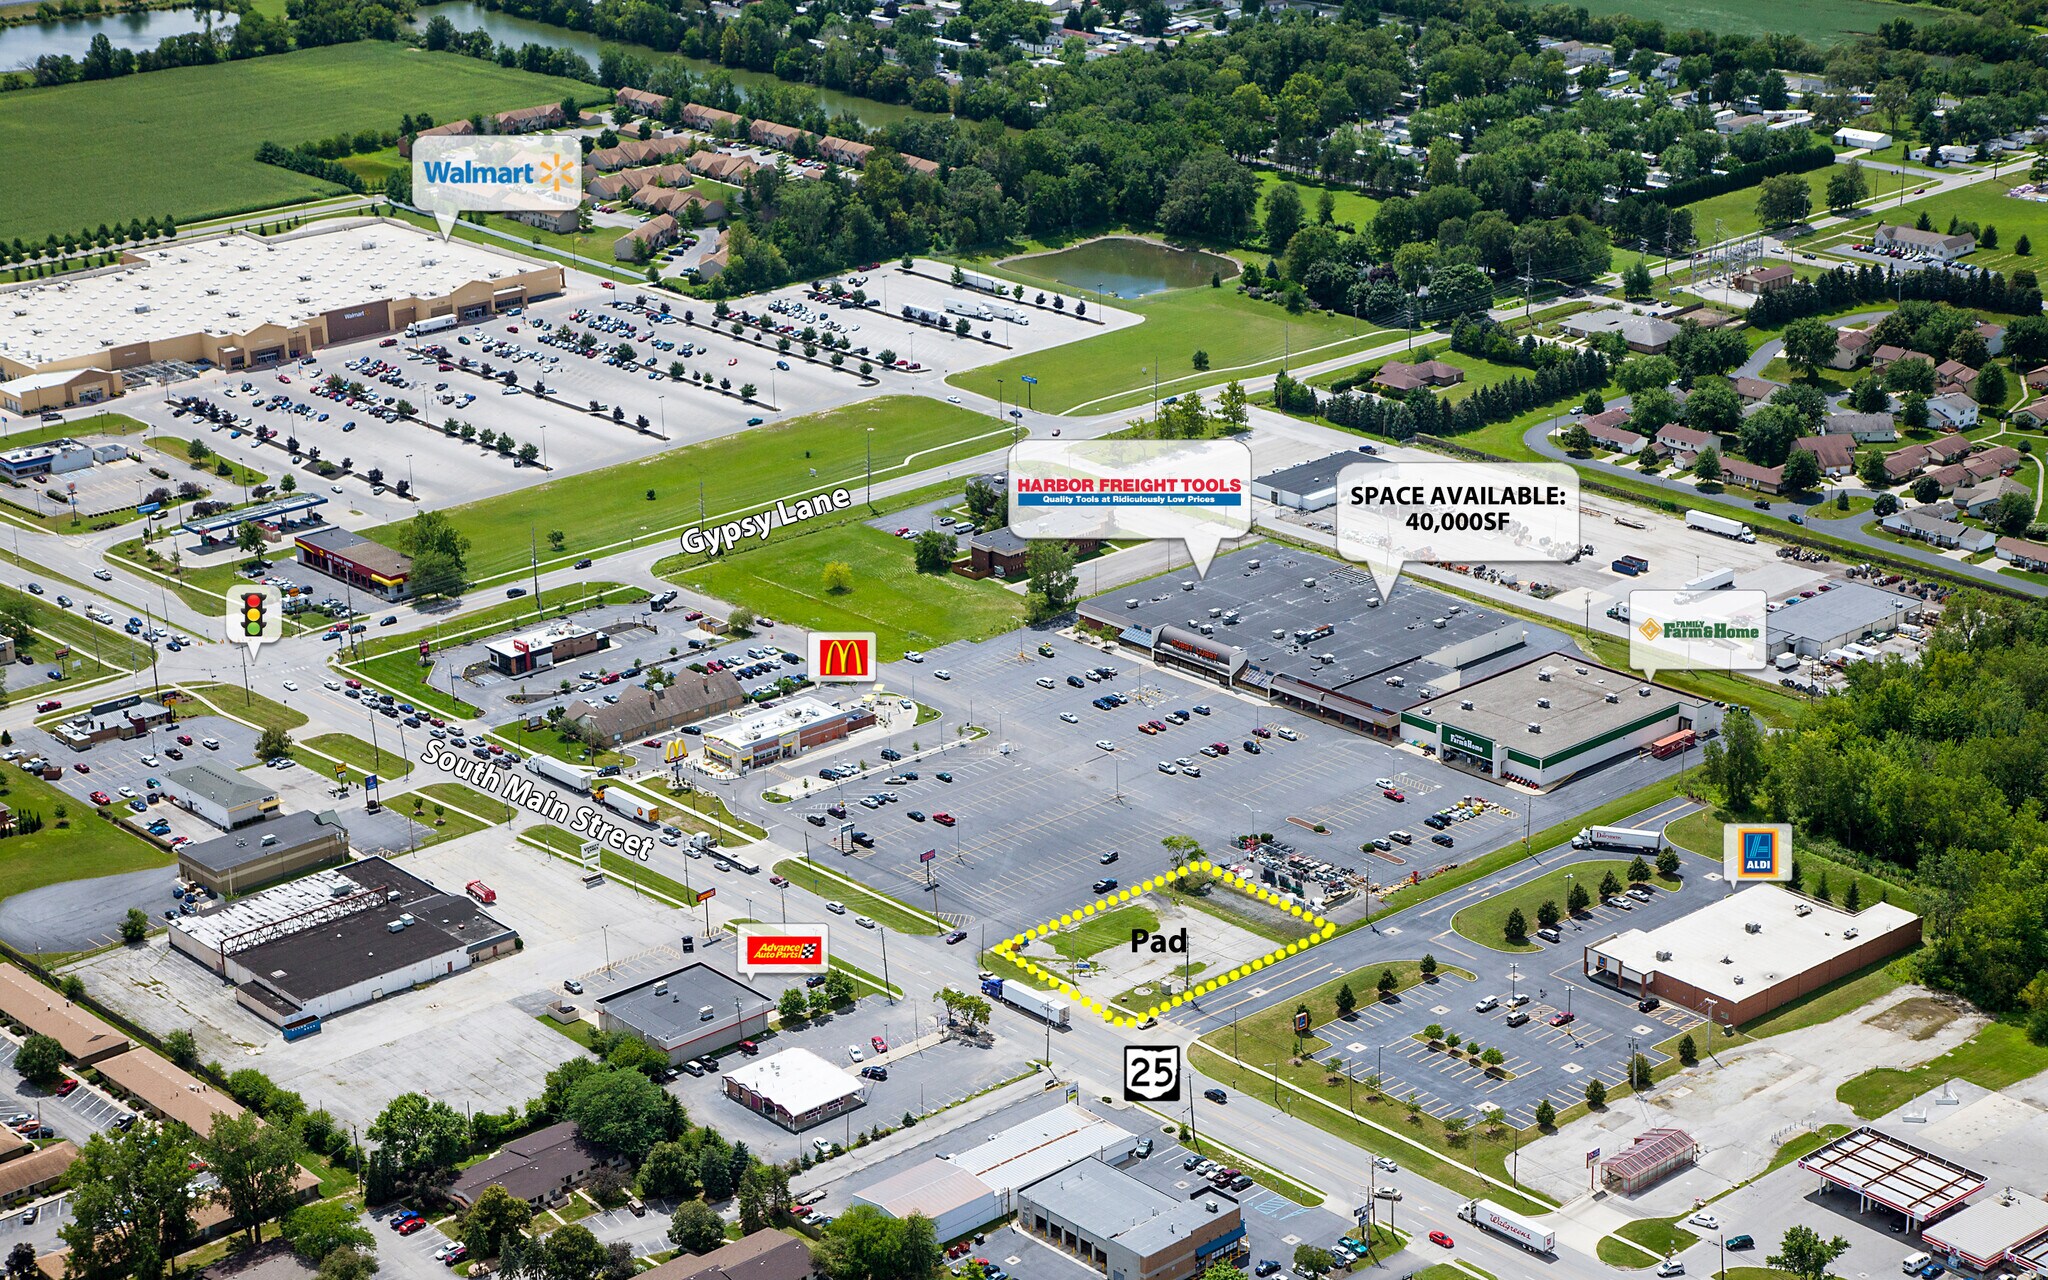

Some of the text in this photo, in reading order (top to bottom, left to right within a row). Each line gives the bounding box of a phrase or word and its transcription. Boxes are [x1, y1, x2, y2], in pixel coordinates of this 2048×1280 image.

[1171, 639, 1194, 652] HOBBY
[1195, 647, 1218, 660] LOBBY
[1489, 1214, 1531, 1240] Walgreens
